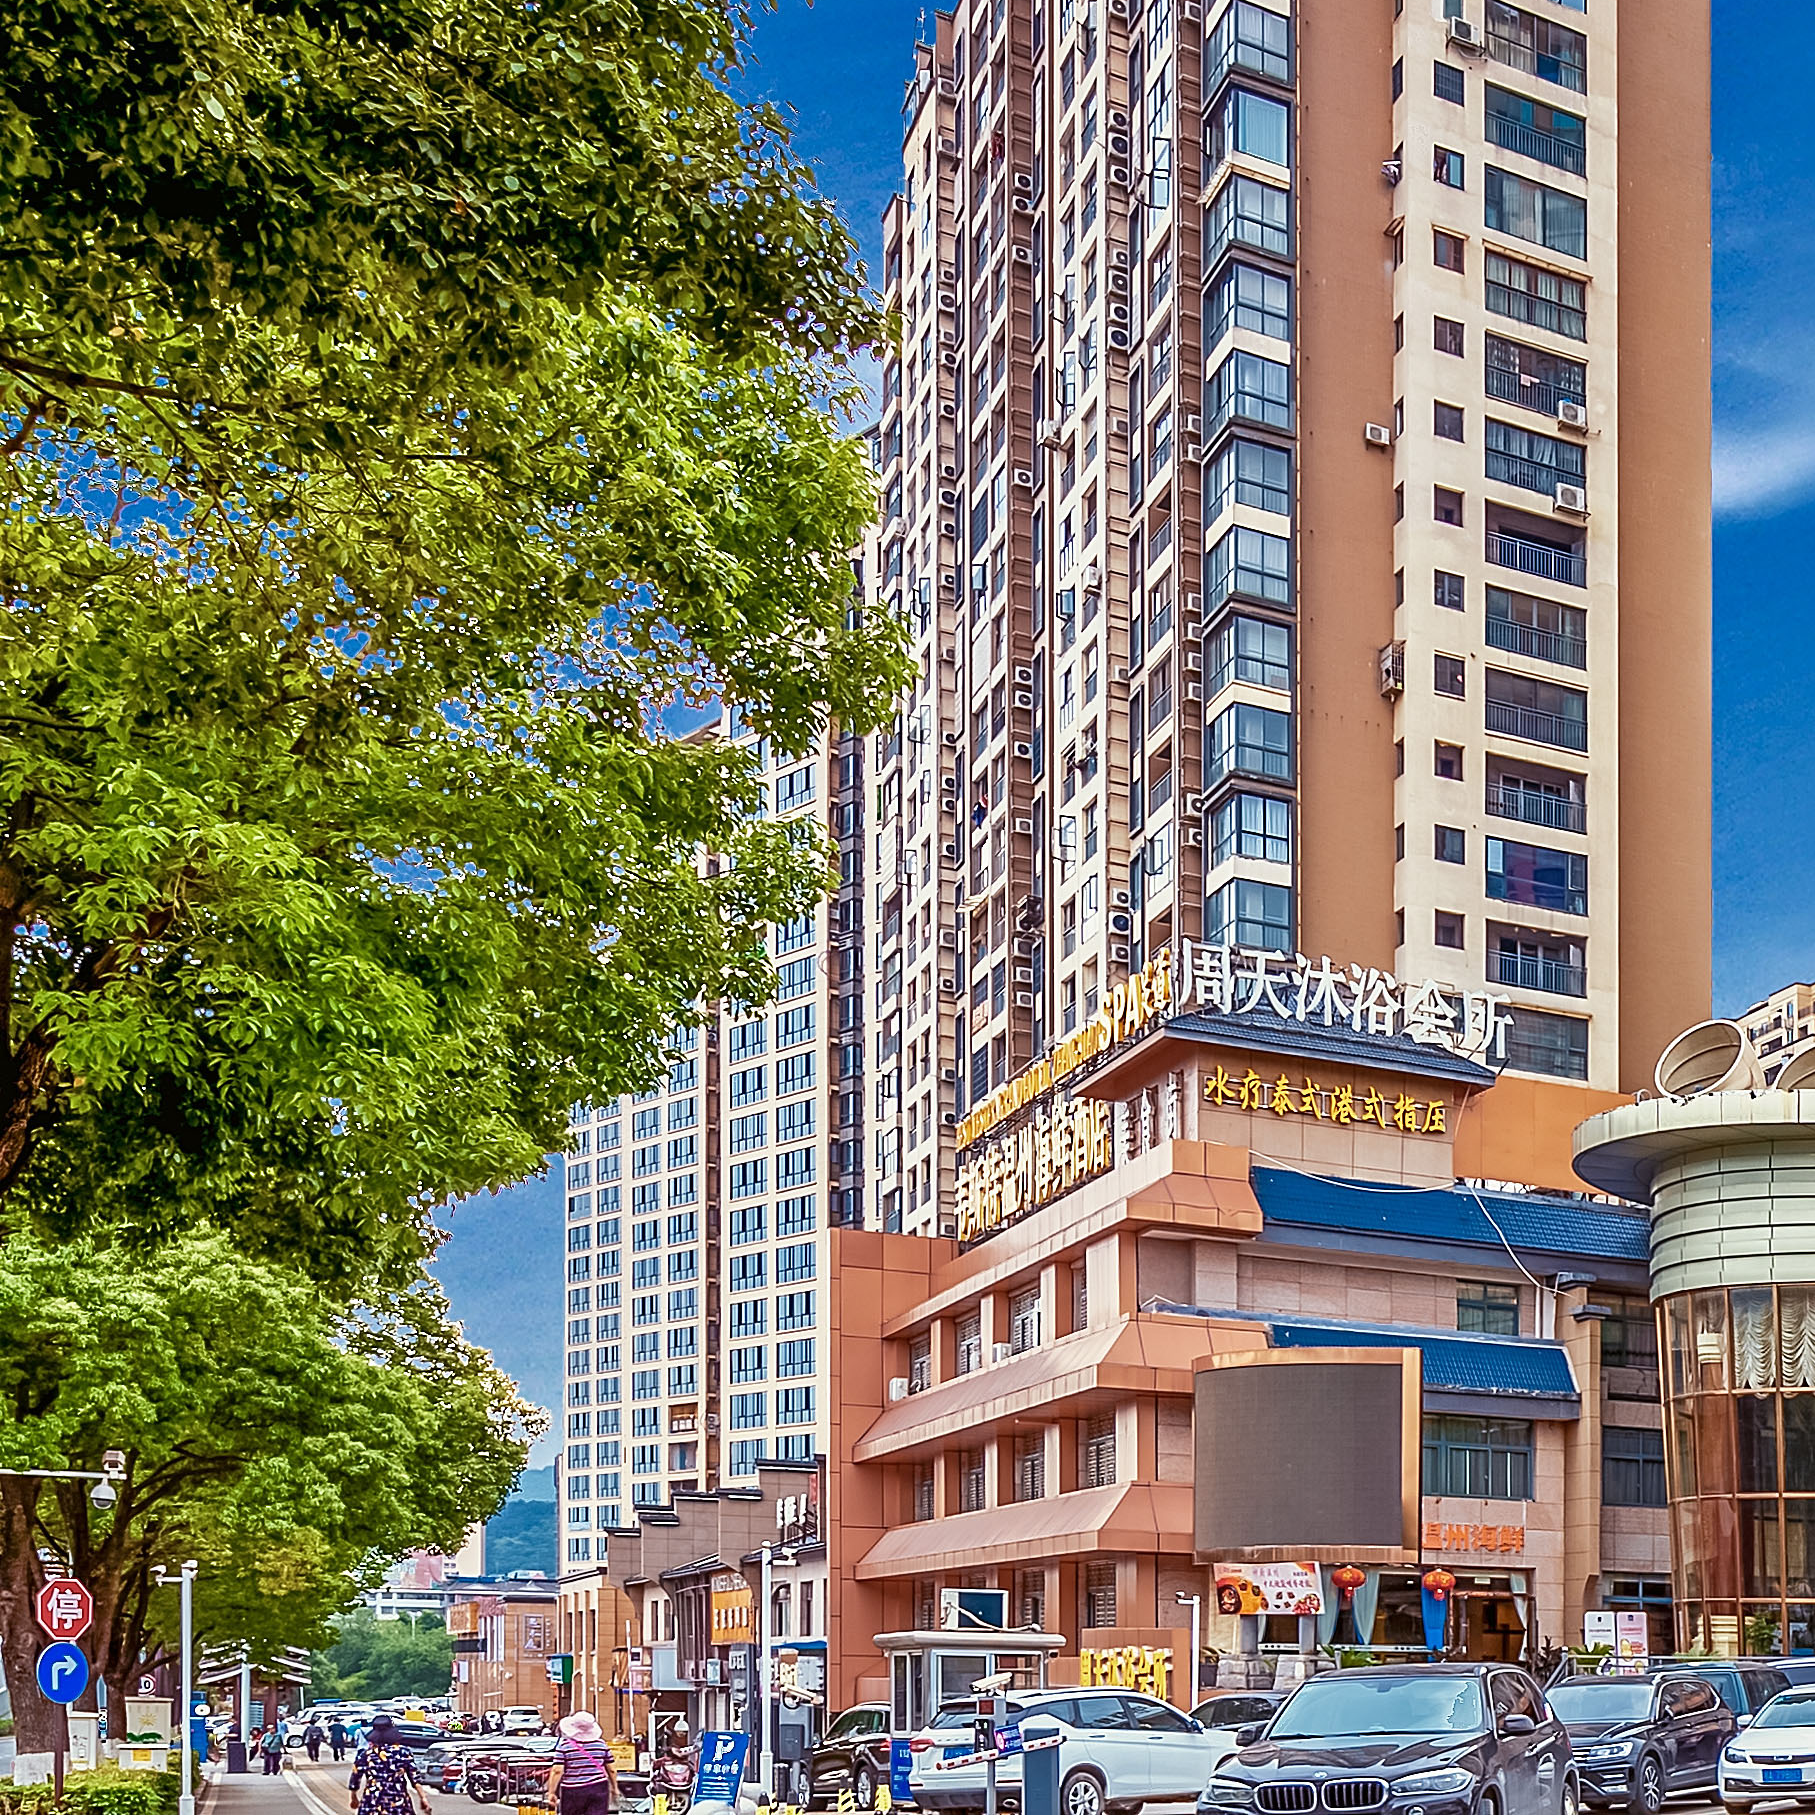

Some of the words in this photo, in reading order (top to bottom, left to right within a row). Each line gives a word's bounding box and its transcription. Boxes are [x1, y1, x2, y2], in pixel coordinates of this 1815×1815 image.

[1178, 937, 1516, 1060] 周天沐浴会所
[1205, 1065, 1447, 1134] 水疗泰式港式指压
[1422, 1522, 1525, 1553] 温州海鲜
[47, 1586, 83, 1630] 停
